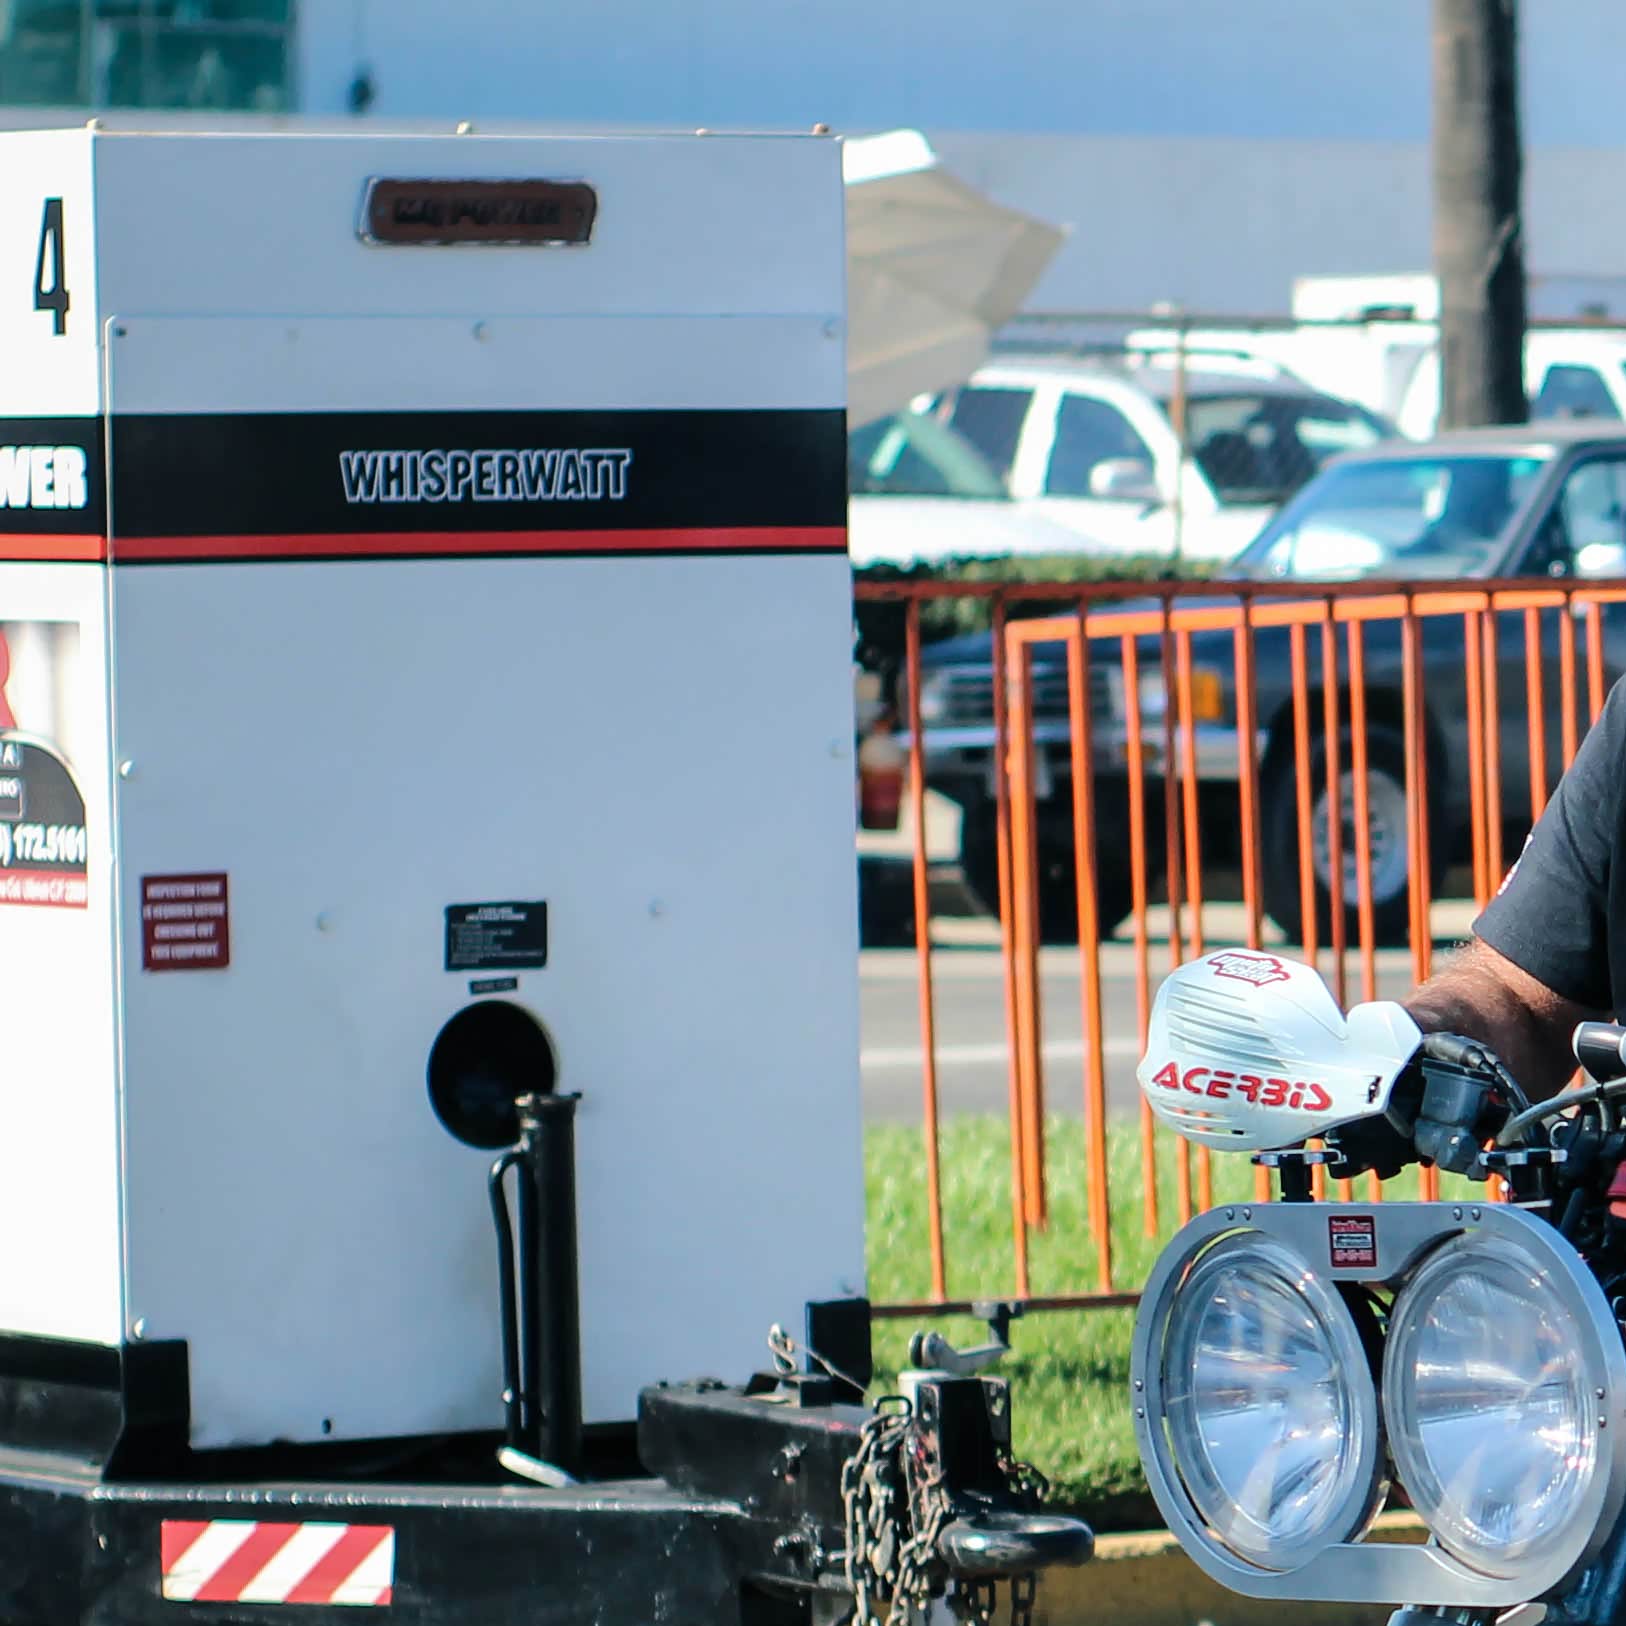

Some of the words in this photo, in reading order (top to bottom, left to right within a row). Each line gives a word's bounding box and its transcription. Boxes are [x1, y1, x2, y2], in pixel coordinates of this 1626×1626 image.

[33, 197, 70, 336] 4
[339, 447, 632, 503] WHISPERWATT
[1152, 1061, 1333, 1112] ACERBIS
